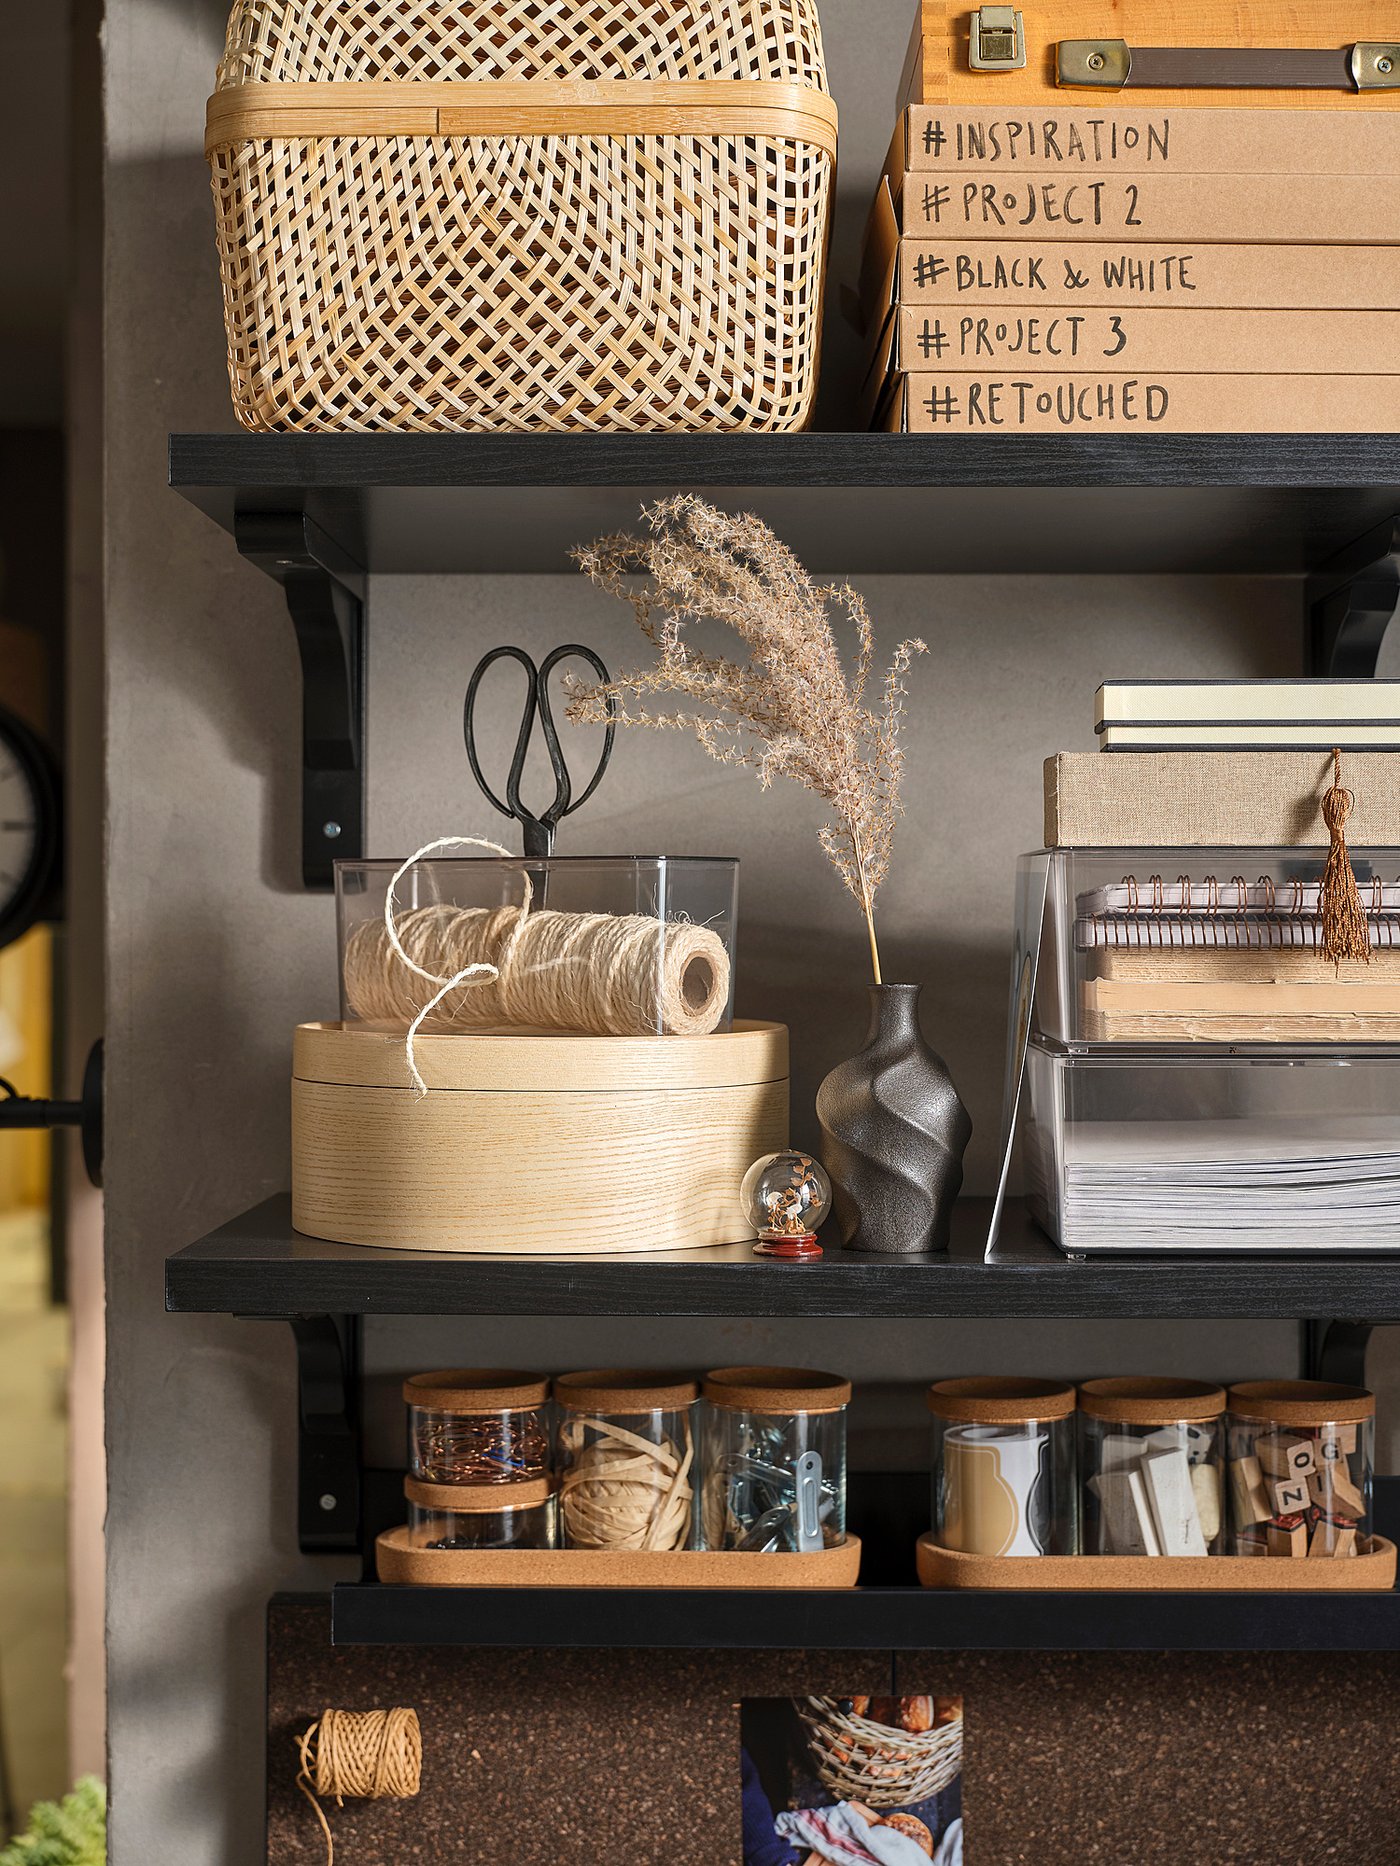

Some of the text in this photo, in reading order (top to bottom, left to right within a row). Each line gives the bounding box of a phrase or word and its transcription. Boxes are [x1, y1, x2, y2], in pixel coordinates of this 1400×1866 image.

[922, 119, 1169, 161] #INSPIRATION
[1124, 185, 1142, 225] 2
[913, 254, 1197, 292] #BLACK & WHITE
[1102, 316, 1127, 356] 3
[922, 381, 1169, 425] #RETOUCHED
